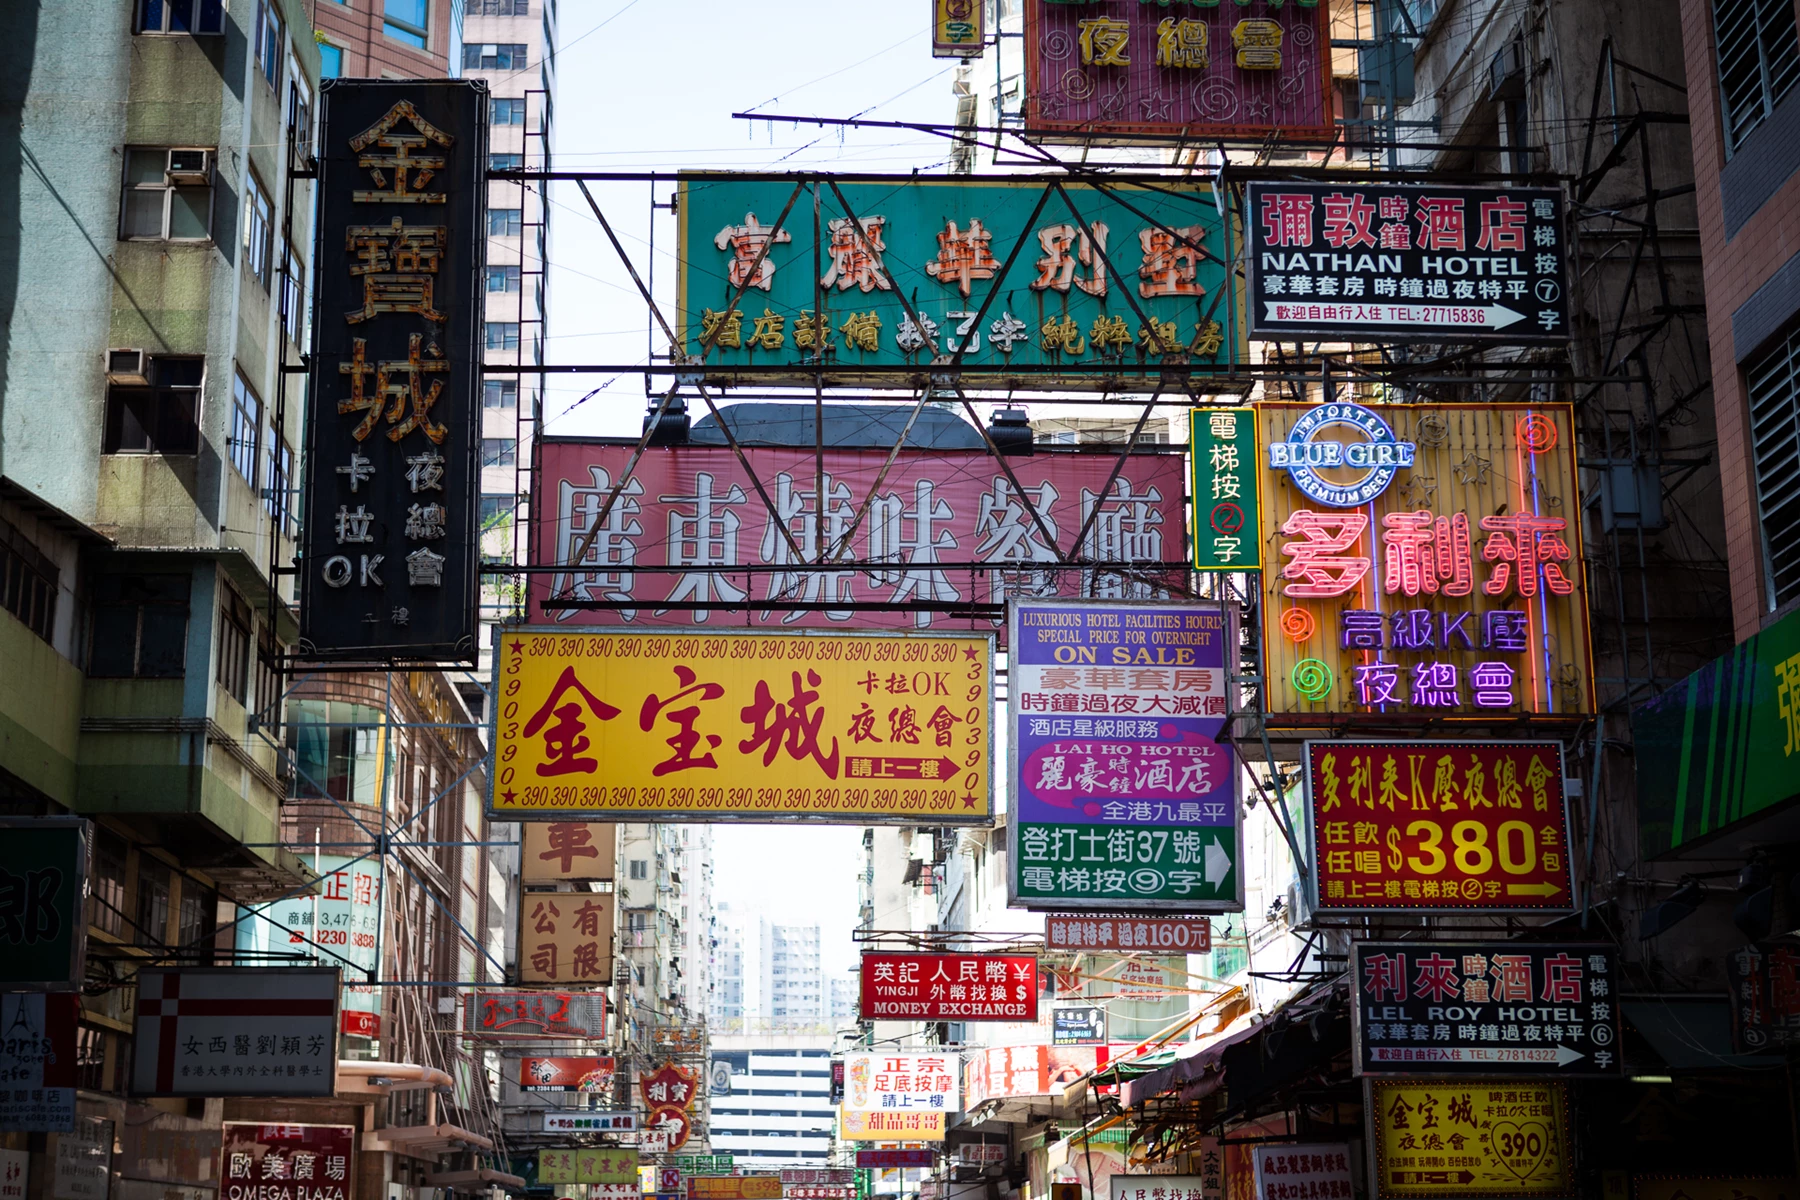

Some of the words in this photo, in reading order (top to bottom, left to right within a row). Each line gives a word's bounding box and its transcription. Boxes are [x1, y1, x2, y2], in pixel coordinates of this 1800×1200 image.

[1078, 16, 1285, 70] 夜總會
[338, 99, 455, 444] 金寶城
[1262, 252, 1402, 273] NATHAN
[1422, 256, 1529, 276] HOTEL
[1263, 275, 1365, 297] 豪華套房
[1374, 278, 1529, 300] 時鐘過夜特平
[1276, 305, 1382, 321] 歡迎自由行入住
[698, 307, 882, 352] 酒店設備
[1294, 405, 1387, 438] IMPORTED
[1271, 442, 1342, 467] BLUE
[1345, 442, 1414, 467] GIRL
[1295, 468, 1360, 504] PREMIUM
[1361, 466, 1392, 499] BEER
[404, 451, 446, 588] 夜總會
[1023, 613, 1081, 627] LUXURIOUS
[1087, 615, 1121, 628] HOTEL
[1126, 615, 1180, 629] FACILITIES
[1037, 629, 1082, 643] SPECIAL
[1089, 631, 1119, 644] PRICE
[1125, 632, 1146, 644] FOR
[1152, 632, 1211, 646] OVERNIGHT
[529, 638, 555, 657] 390
[558, 638, 584, 657] 390
[586, 638, 612, 658] 390
[615, 639, 641, 658] 390
[644, 639, 670, 658] 390
[673, 639, 699, 659] 390
[701, 640, 727, 659] 390
[730, 640, 756, 660] 390
[759, 640, 785, 660] 390
[787, 641, 813, 660] 390
[816, 641, 842, 661] 390
[845, 641, 871, 661] 390
[874, 642, 900, 661] 390
[902, 642, 928, 662] 390
[931, 642, 957, 662] 390
[1054, 645, 1098, 664] ON
[1113, 647, 1196, 665] SALE
[857, 670, 951, 696] 卡拉OK
[1040, 667, 1213, 692] 豪華套房
[1355, 661, 1515, 706] 夜總會
[1021, 692, 1226, 715] 時鐘過夜大減價
[847, 703, 962, 748] 夜總會
[1029, 718, 1158, 738] 酒店星級服務
[1054, 744, 1092, 754] LAI
[1101, 744, 1132, 755] HO
[1141, 745, 1215, 756] HOTEL
[851, 758, 940, 778] 請上一樓
[522, 786, 548, 806] 390
[551, 787, 577, 806] 390
[580, 787, 606, 806] 390
[609, 787, 635, 807] 390
[638, 787, 664, 807] 390
[667, 788, 694, 807] 390
[696, 788, 723, 808] 390
[725, 788, 752, 808] 390
[754, 788, 781, 808] 390
[783, 789, 810, 808] 390
[812, 789, 839, 808] 390
[841, 789, 868, 809] 390
[870, 789, 897, 809] 390
[899, 789, 926, 809] 390
[928, 790, 956, 810] 390
[1102, 801, 1226, 822] 全港九最平
[1323, 821, 1379, 845] 任飲
[1022, 827, 1201, 864] 登打士街37號
[1386, 820, 1537, 875] $380
[1539, 825, 1560, 872] 全包
[1325, 850, 1382, 874] 任唱
[530, 900, 560, 979] 公司
[573, 900, 603, 978] 有限
[874, 962, 920, 983] 英記
[929, 960, 1008, 982] 人民幣
[876, 985, 918, 997] YINGJI
[930, 984, 1008, 1001] 外幣找換
[874, 1002, 931, 1015] MONEY
[938, 1003, 1026, 1016] EXCHANGE
[1368, 1007, 1412, 1020] LEL
[1428, 1007, 1482, 1021] ROY
[1498, 1008, 1584, 1022] HOTEL
[1367, 1023, 1451, 1040] 豪華套房
[1458, 1025, 1585, 1042] 時鐘過夜特平
[182, 1034, 325, 1056] 女西醫劉穎芳
[1378, 1048, 1462, 1061] 歡迎自由行入住
[882, 1057, 945, 1073] 正宗
[874, 1074, 953, 1093] 足底按摩
[882, 1094, 944, 1108] 請上一樓
[1488, 1091, 1548, 1103] 啤酒任飲
[868, 1112, 940, 1131] 甜品哥哥
[1398, 1133, 1470, 1151] 夜總會
[1501, 1133, 1542, 1157] 390
[229, 1153, 346, 1181] 歐美廣場
[1403, 1173, 1460, 1184] 請上一樓
[229, 1185, 291, 1200] OMEGA
[297, 1186, 345, 1200] PLAZA
